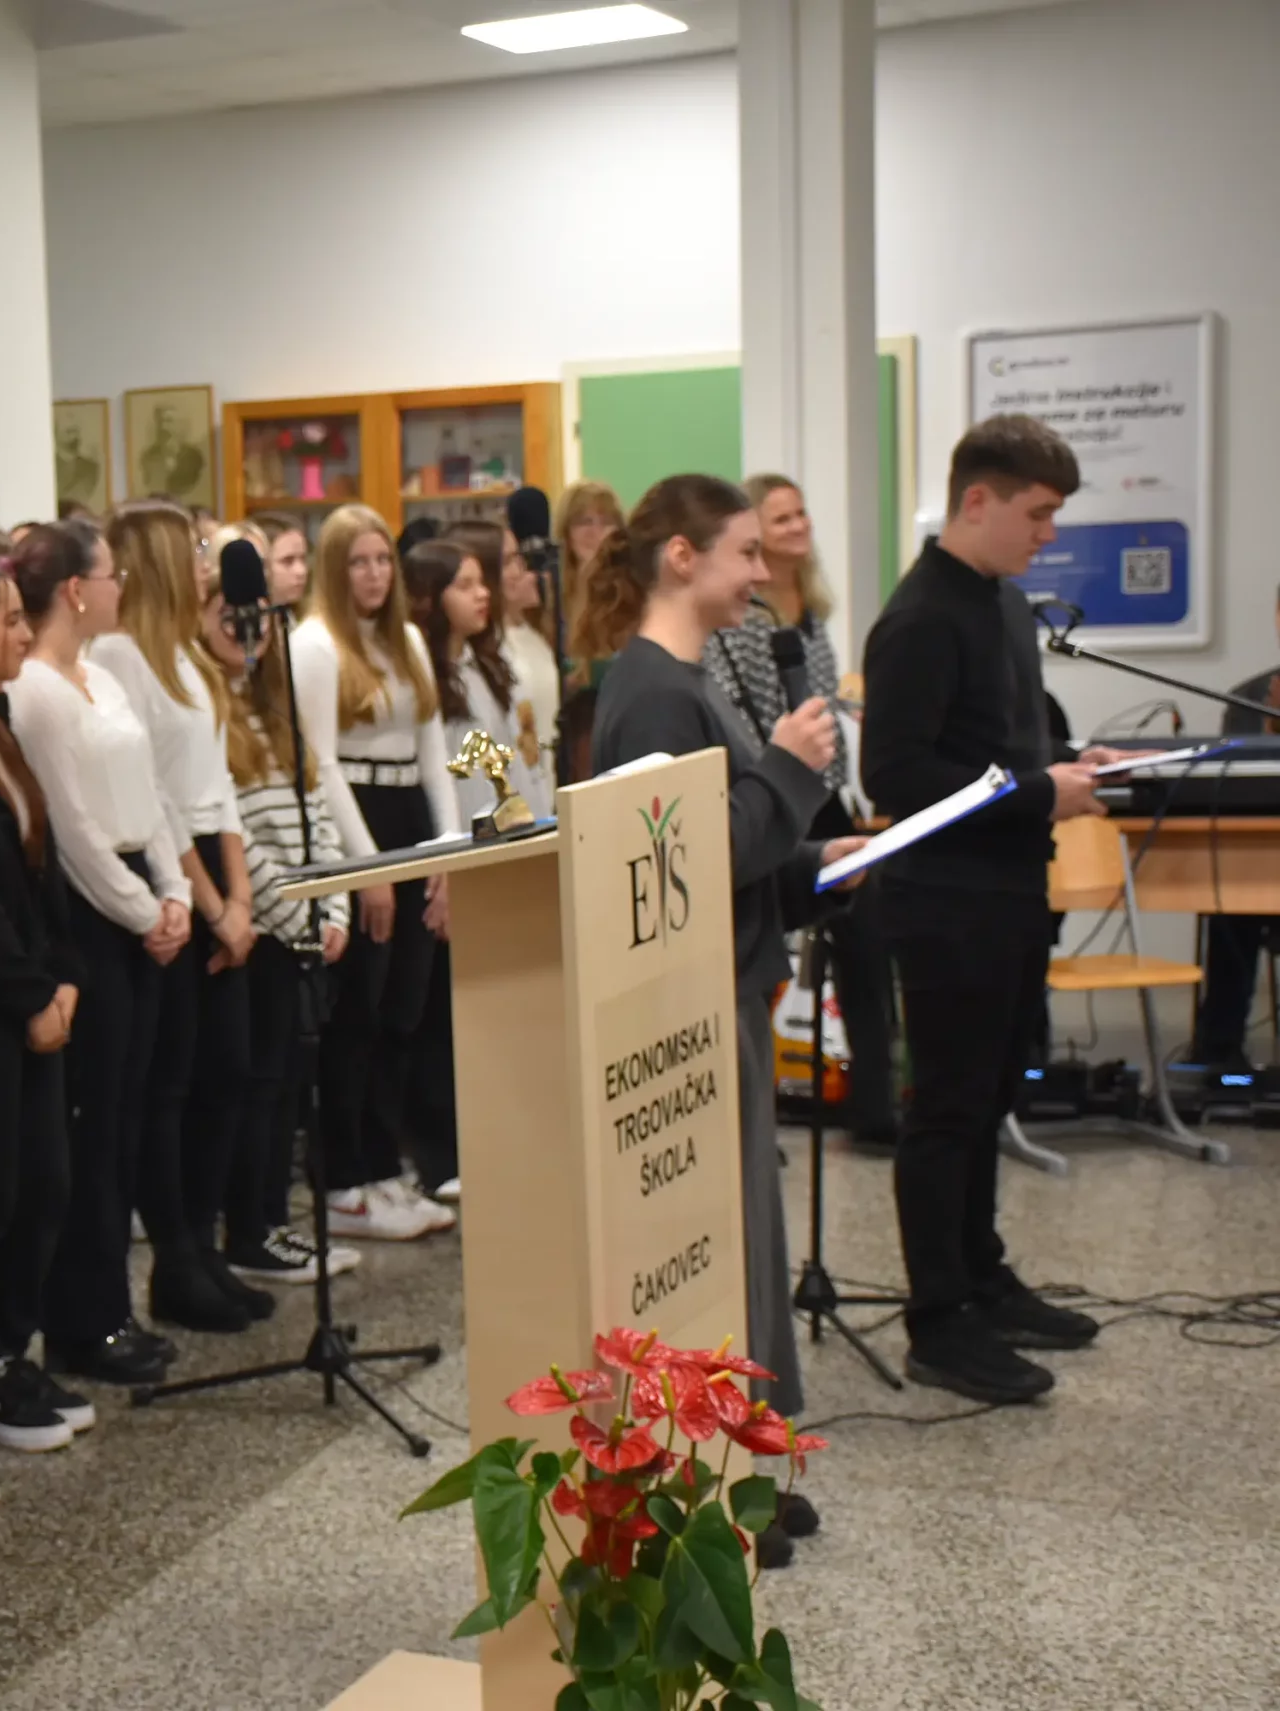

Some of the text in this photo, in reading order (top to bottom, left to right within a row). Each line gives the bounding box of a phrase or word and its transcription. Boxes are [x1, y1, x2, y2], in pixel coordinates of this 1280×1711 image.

[604, 1010, 721, 1102] EKONOMSKA I
[613, 1067, 718, 1155] TRGOVAČKA
[640, 1135, 697, 1198] ŠKOLA
[631, 1233, 712, 1317] ČAKOVEC
